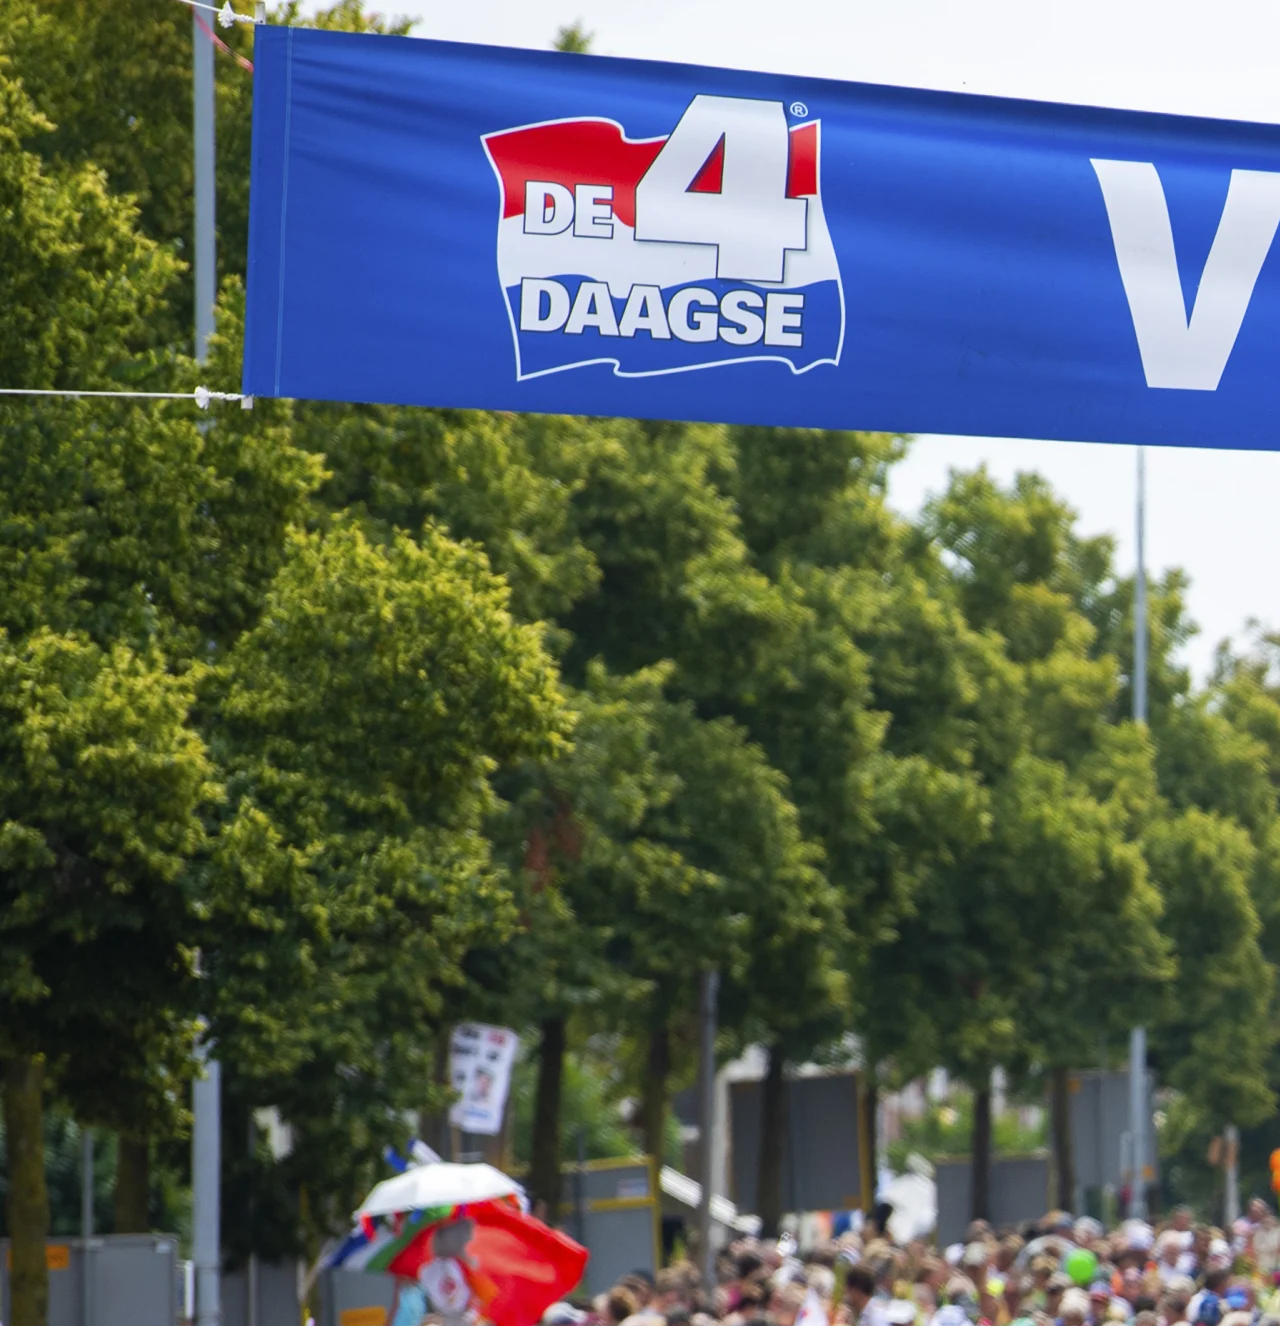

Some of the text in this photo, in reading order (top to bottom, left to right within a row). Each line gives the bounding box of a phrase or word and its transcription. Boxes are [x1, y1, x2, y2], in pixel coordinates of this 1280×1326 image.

[523, 93, 809, 284] DE 4
[519, 276, 805, 349] DAAGSE
